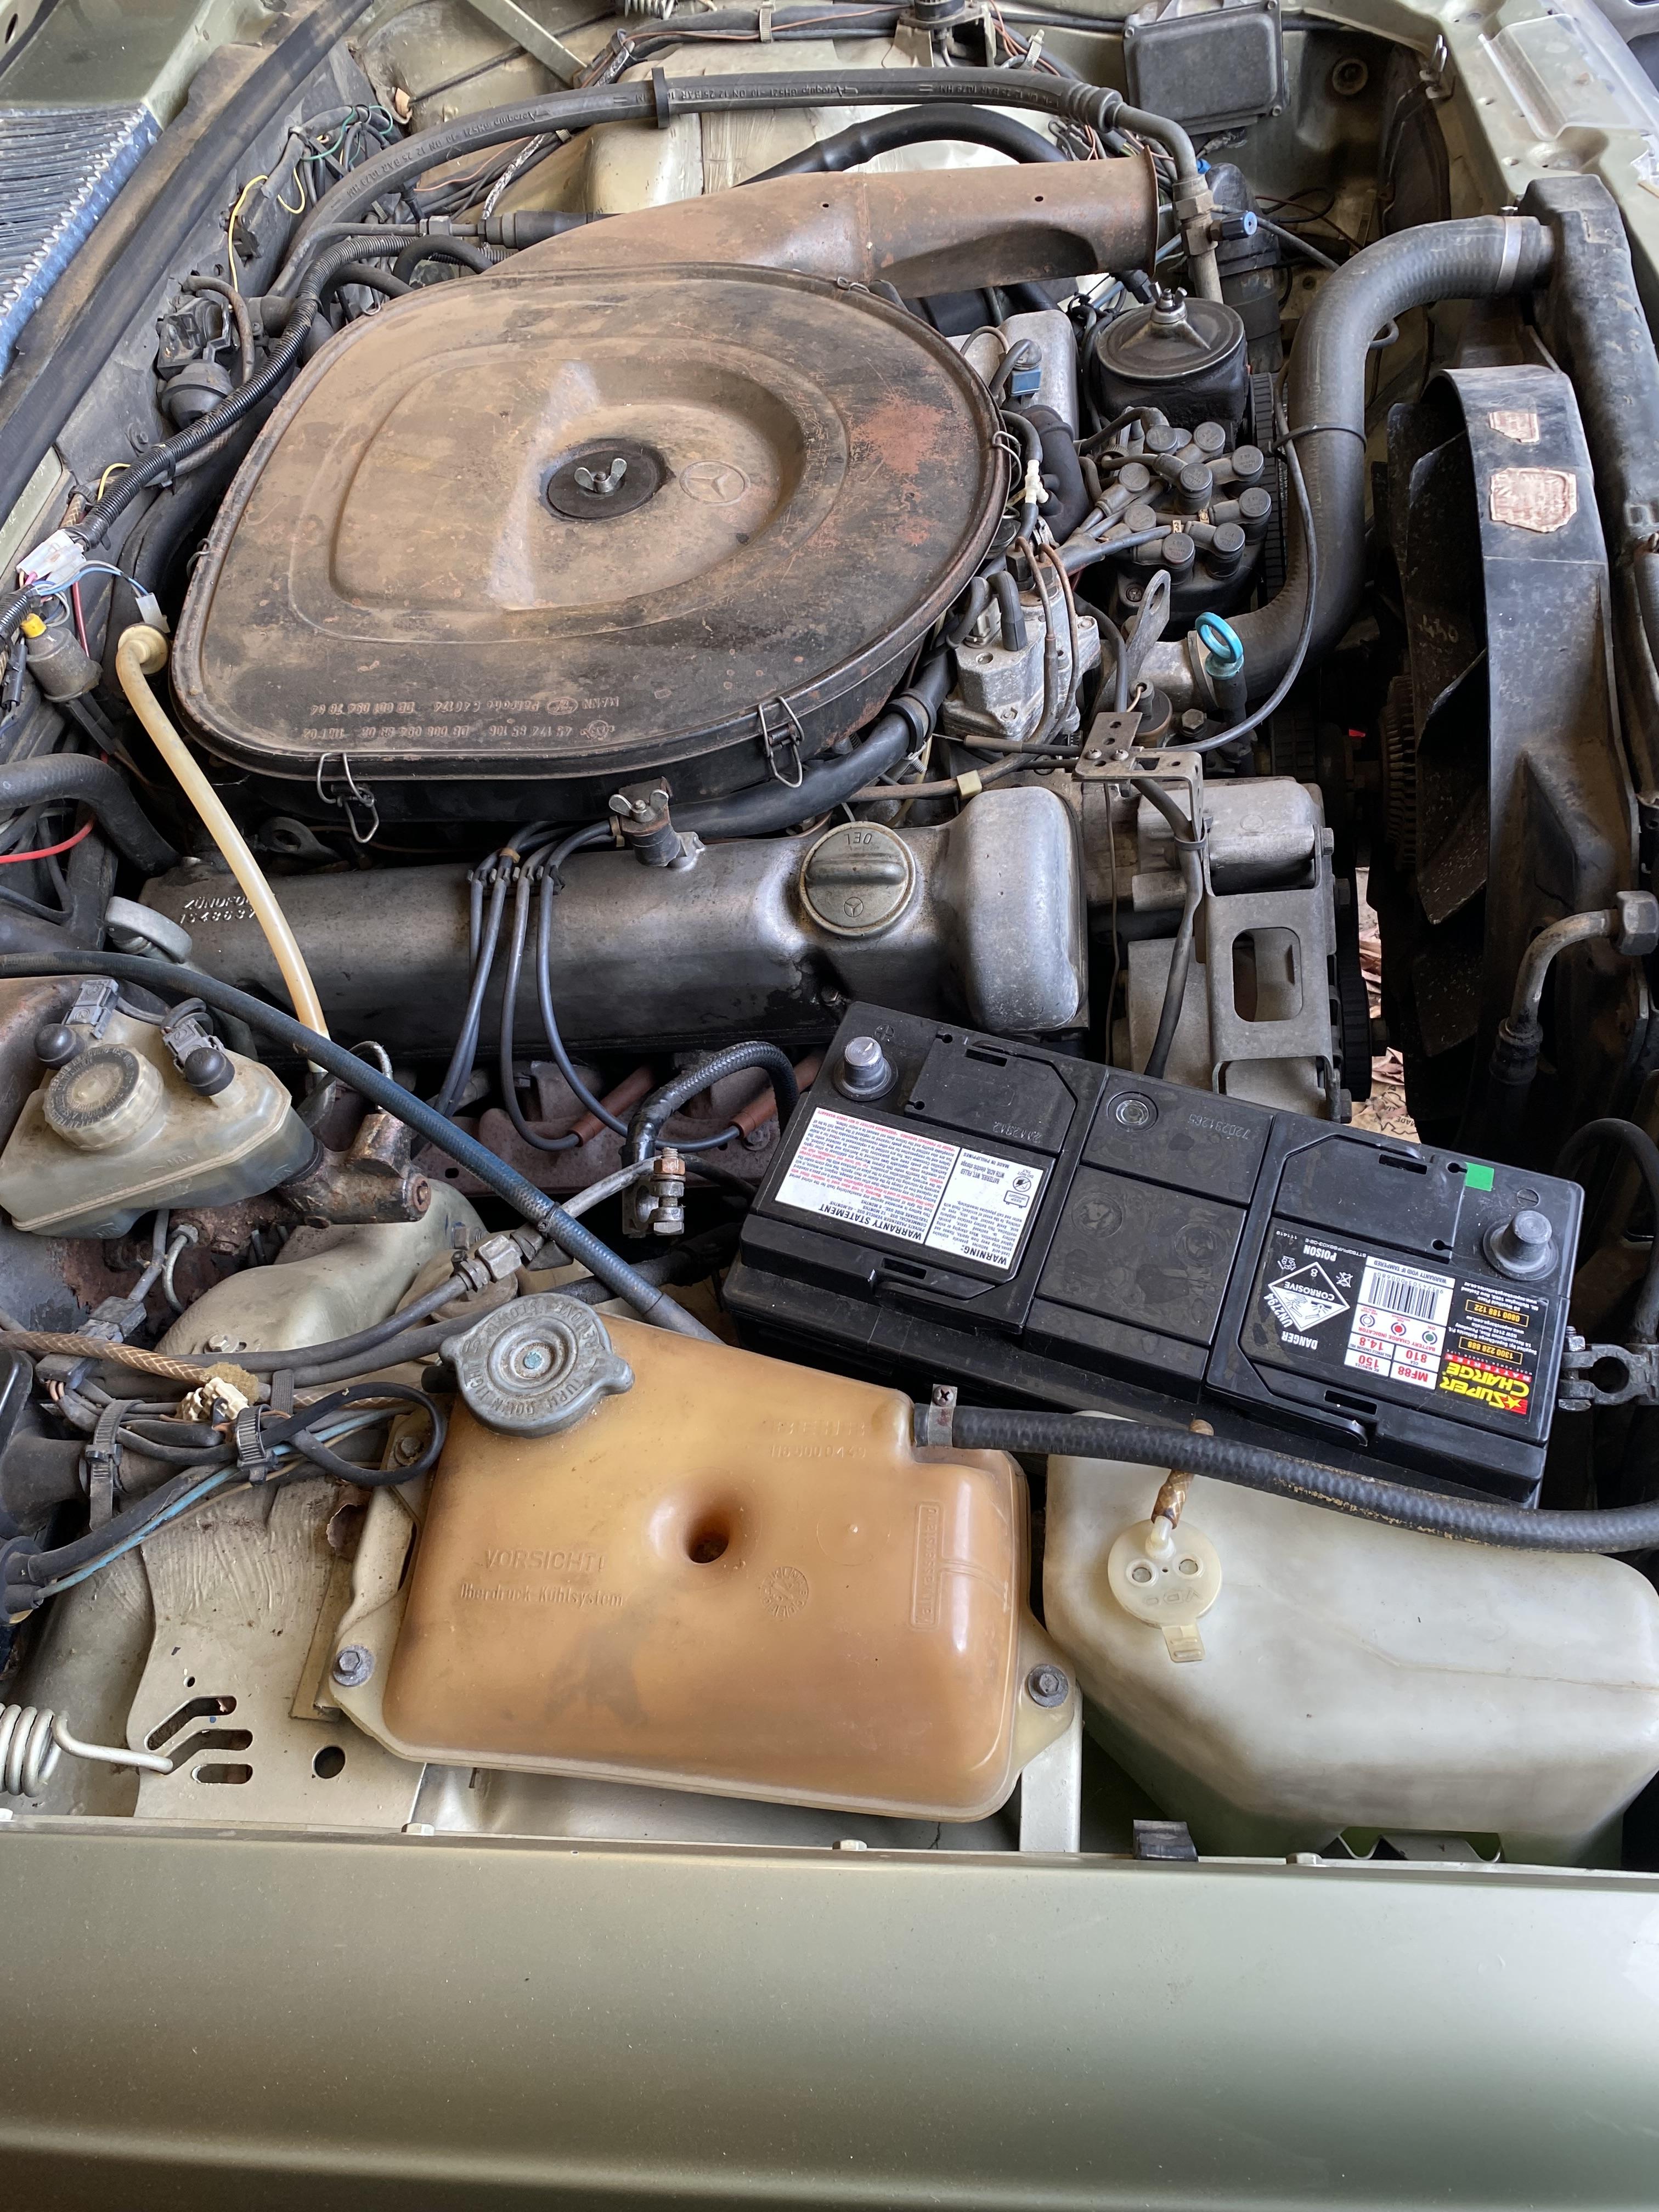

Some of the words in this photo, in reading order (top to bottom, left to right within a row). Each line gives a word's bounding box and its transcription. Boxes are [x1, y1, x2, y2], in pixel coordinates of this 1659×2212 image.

[681, 90, 702, 100] BAR
[843, 832, 879, 845] OEL
[963, 1152, 990, 1163] PHILIPPINES
[960, 1160, 974, 1169] storage
[960, 1168, 972, 1176] FILLED
[860, 1199, 878, 1207] MONTHS
[817, 1203, 871, 1224] STATEMENT
[865, 1211, 883, 1220] VEHICLE
[899, 1216, 927, 1227] COMMERCIAL
[871, 1219, 922, 1240] WARRANTY
[907, 1223, 925, 1232] PRIVATE
[960, 1244, 1008, 1265] WARNING:
[1303, 1244, 1337, 1262] POISON
[1374, 1260, 1400, 1271] TAMPERED
[1310, 1267, 1318, 1277] 8
[1420, 1272, 1446, 1284] WARRANTY
[1284, 1280, 1335, 1301] CORROSIVE
[1460, 1286, 1480, 1295] Zealand
[1474, 1303, 1487, 1313] 122
[1491, 1299, 1513, 1310] Westfield
[1504, 1297, 1530, 1308] Wellington
[1263, 1293, 1294, 1328] UN2794
[1503, 1311, 1520, 1322] 0800
[1471, 1322, 1492, 1331] Australia
[1456, 1328, 1477, 1339] Batteries
[1280, 1330, 1318, 1350] DANGER
[1358, 1336, 1384, 1351] 14.8
[1387, 1335, 1410, 1345] CHARGE
[1491, 1333, 1524, 1346] Reconciliation
[1411, 1341, 1435, 1351] BATTERY
[1481, 1345, 1495, 1354] 228
[1516, 1344, 1537, 1355] Supplied
[1405, 1350, 1427, 1363] 810
[1496, 1348, 1514, 1359] 1300
[1358, 1355, 1380, 1368] 150
[1397, 1365, 1428, 1382] MF88
[1447, 1355, 1530, 1381] BATTERIES
[1445, 1361, 1530, 1399] CHARGE
[1438, 1375, 1508, 1409] SUPER
[486, 1549, 606, 1572] VORSICHT!
